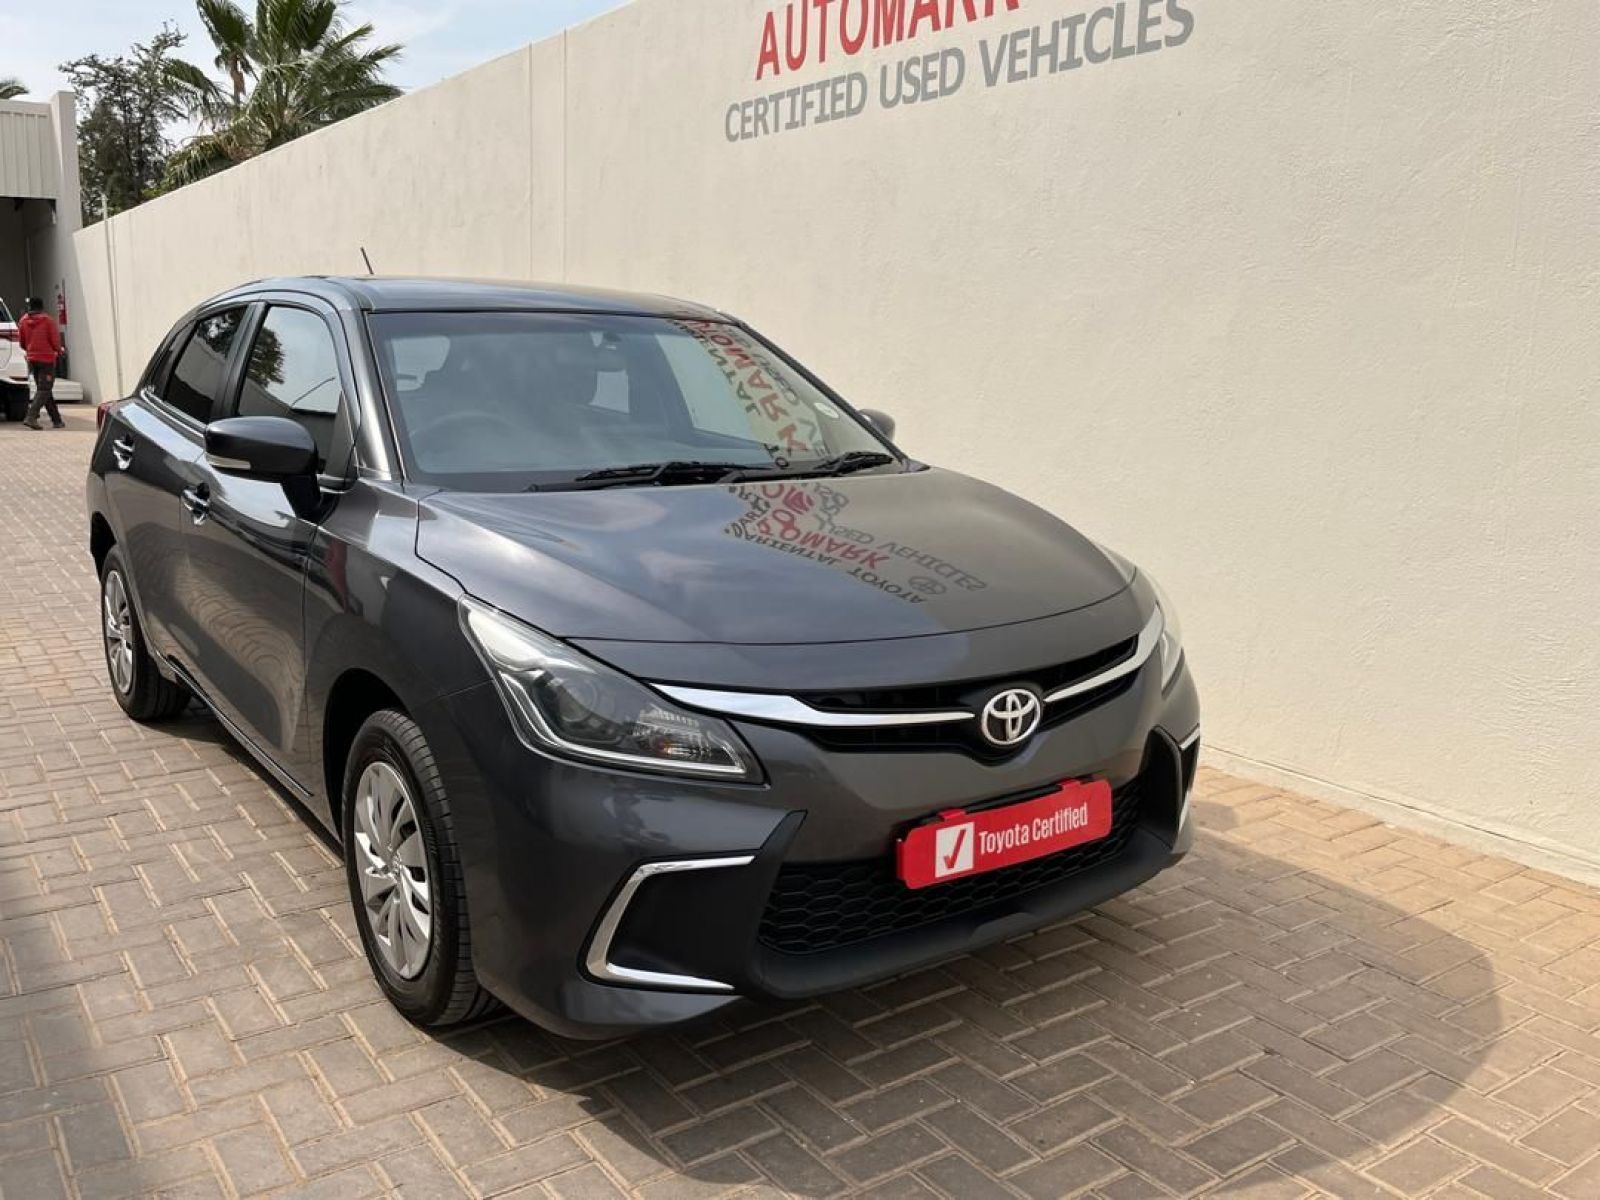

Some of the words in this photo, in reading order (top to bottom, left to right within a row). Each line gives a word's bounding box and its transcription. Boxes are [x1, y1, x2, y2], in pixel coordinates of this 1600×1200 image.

[725, 73, 867, 142] CERTIFIED
[879, 47, 965, 109] USED
[979, 0, 1195, 88] VEHICLES
[755, 0, 1019, 81] AUTOMA
[979, 825, 1029, 855] Toyota
[1033, 803, 1088, 841] Certified
